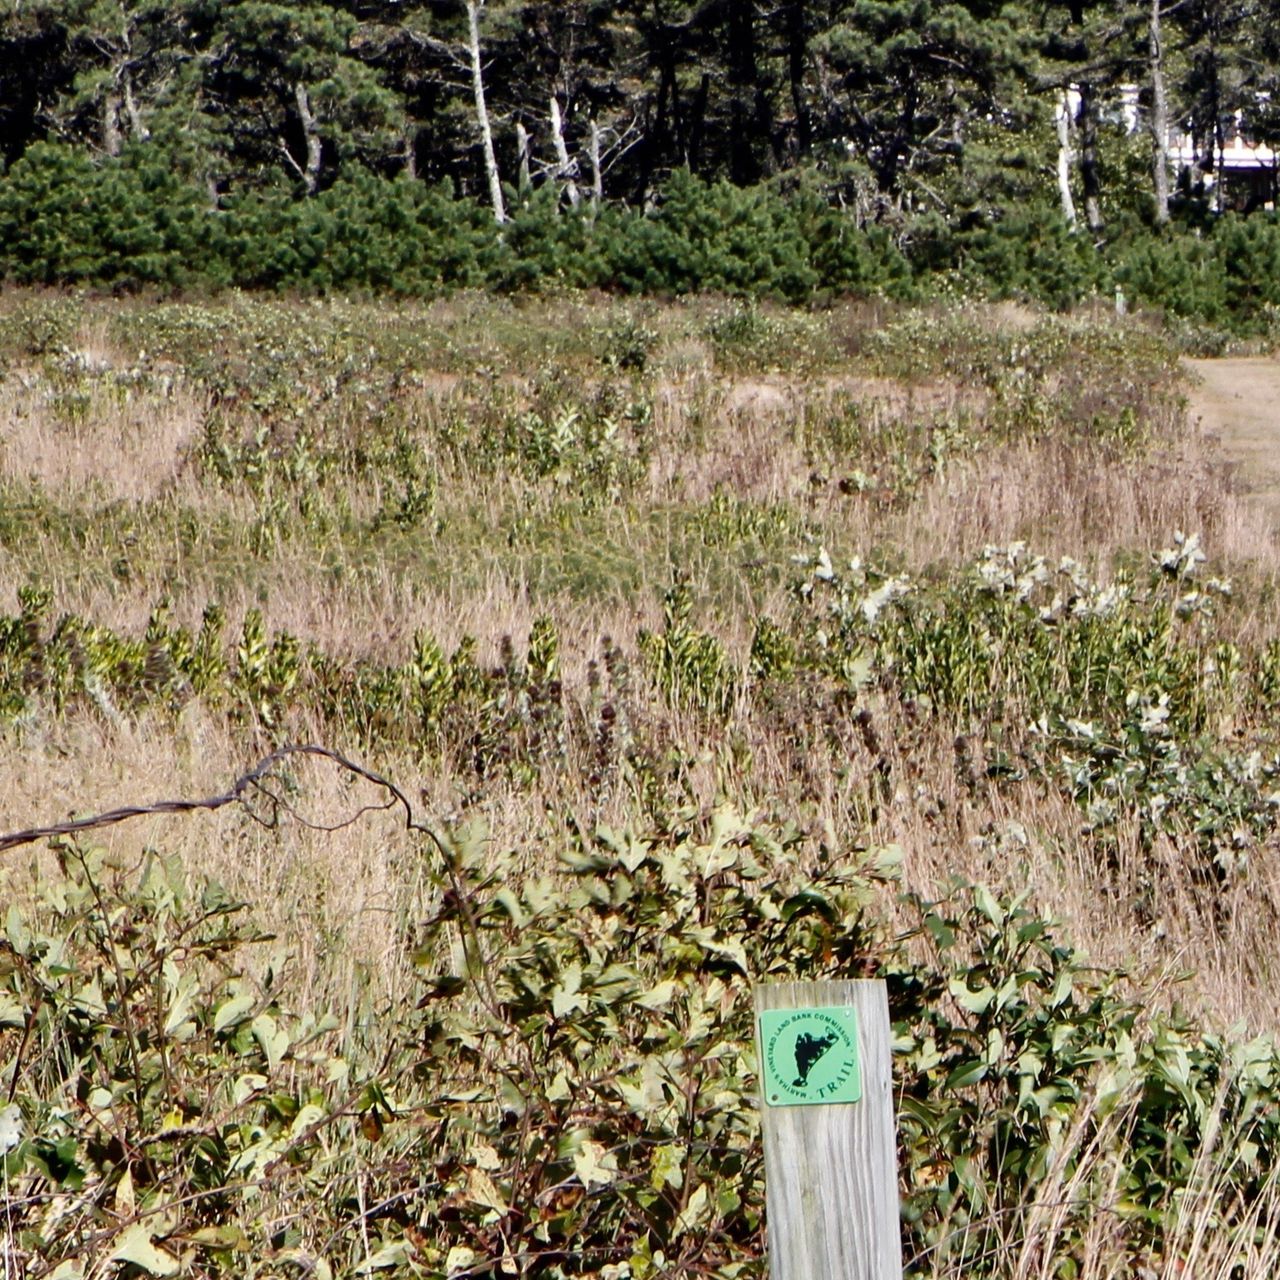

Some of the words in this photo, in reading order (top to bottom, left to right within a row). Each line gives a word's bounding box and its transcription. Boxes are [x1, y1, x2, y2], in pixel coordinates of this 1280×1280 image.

[775, 1019, 791, 1036] LAND
[791, 1013, 812, 1022] BANK
[814, 1013, 851, 1047] COMMISSION
[816, 1059, 854, 1099] TRAIL
